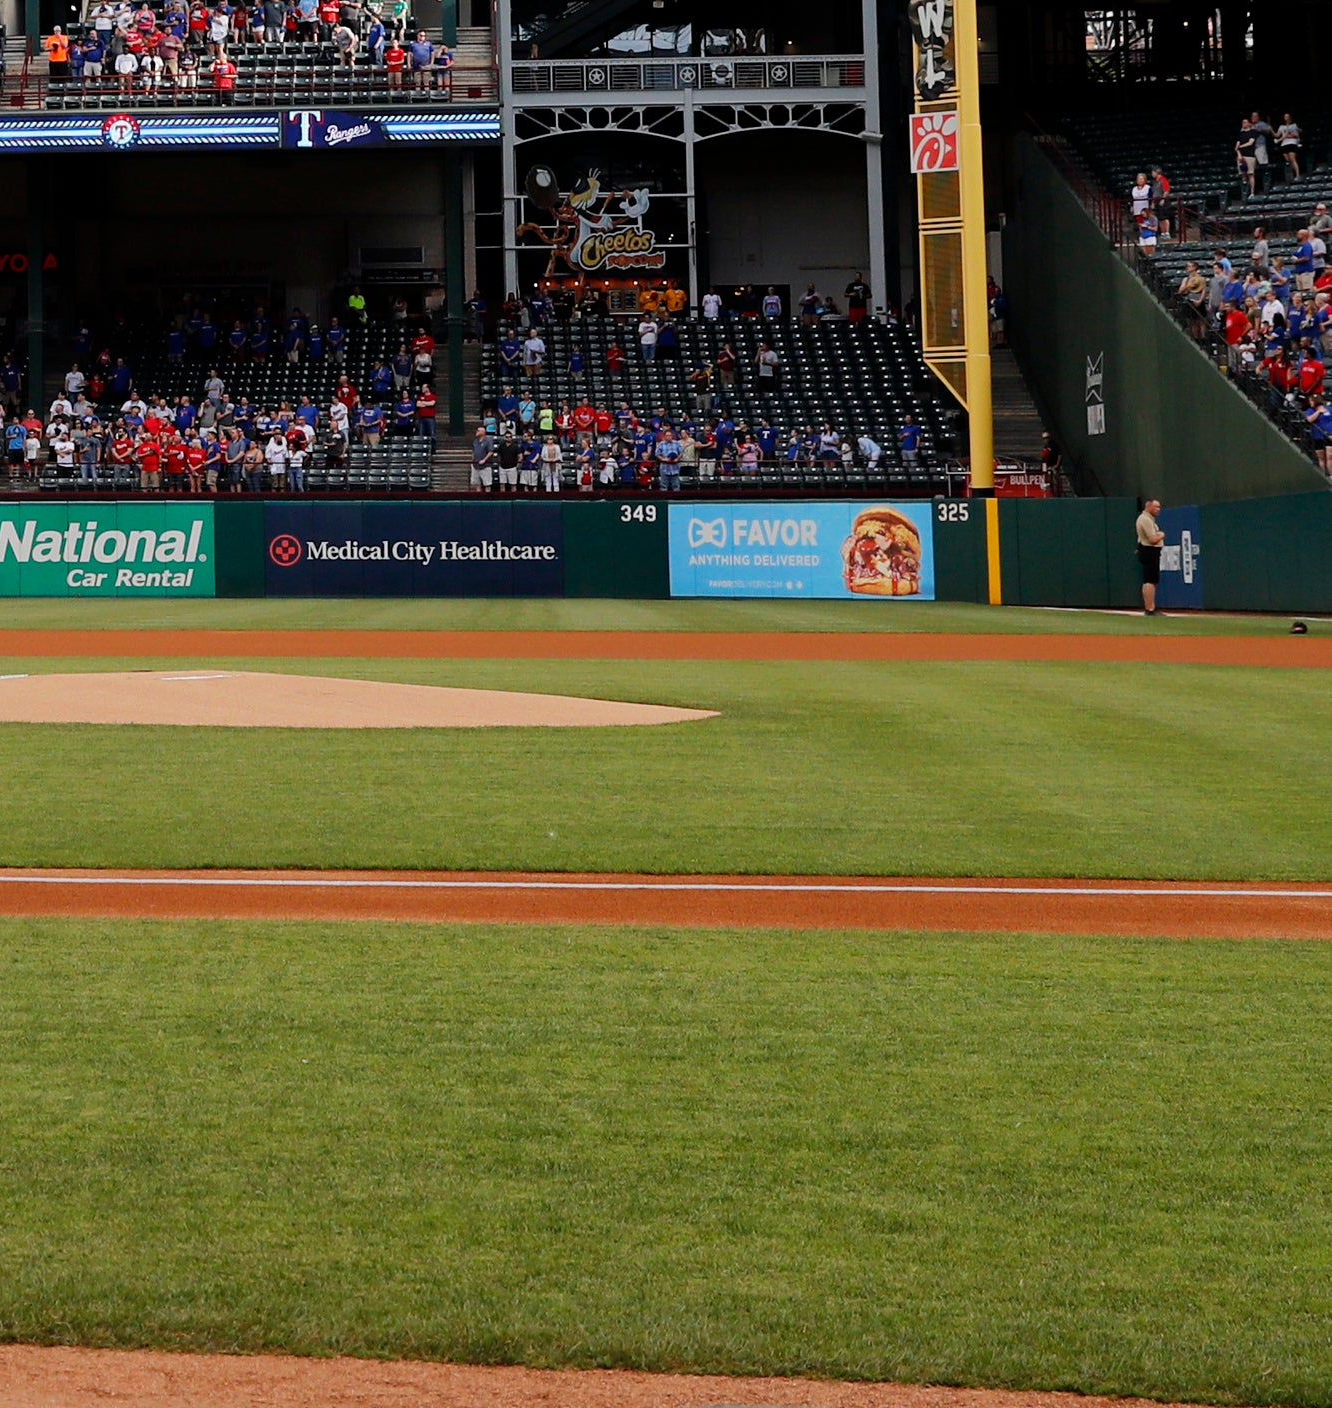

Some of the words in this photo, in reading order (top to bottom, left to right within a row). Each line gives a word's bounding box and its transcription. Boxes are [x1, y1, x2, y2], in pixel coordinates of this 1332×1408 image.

[288, 110, 322, 148] T
[324, 122, 372, 147] Rangers
[579, 229, 653, 266] Cheetos
[620, 504, 657, 523] 349
[937, 502, 970, 522] 325
[732, 519, 819, 547] FAVOR
[306, 539, 390, 563] Medical
[392, 539, 438, 567] City
[440, 539, 556, 563] Healthcare
[689, 554, 751, 567] ANYTHING
[753, 554, 821, 567] DELIVERED
[66, 569, 113, 587] Car
[115, 569, 194, 587] Rental
